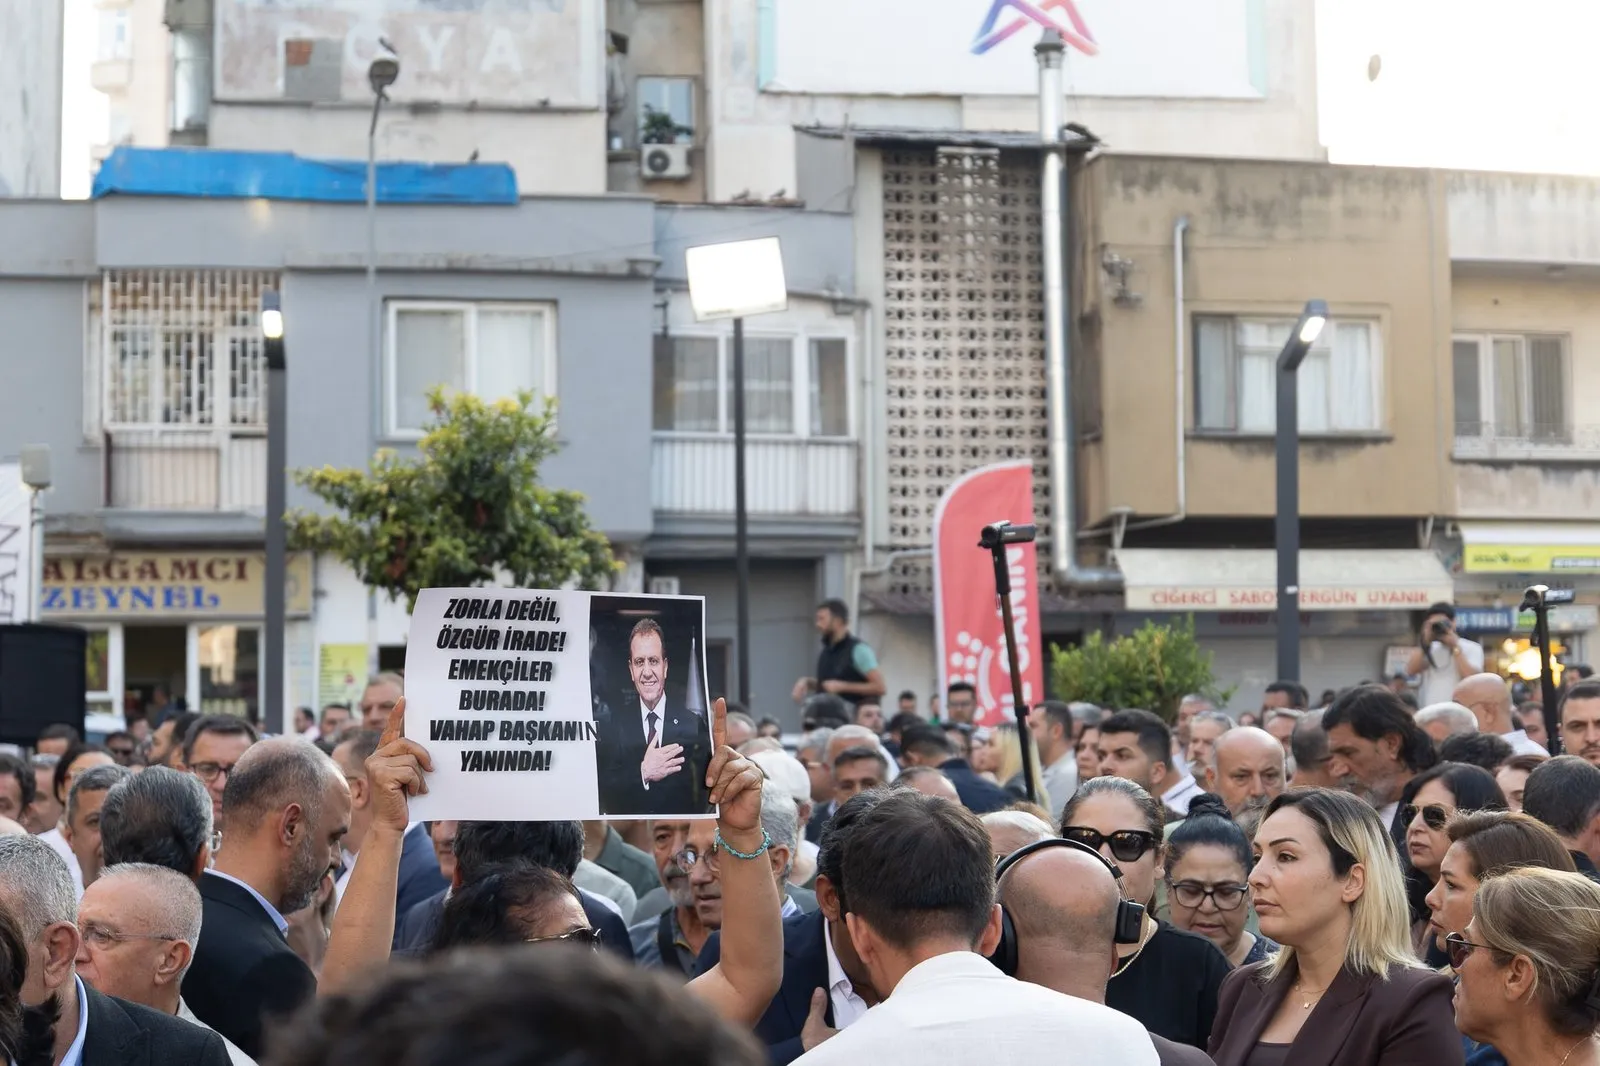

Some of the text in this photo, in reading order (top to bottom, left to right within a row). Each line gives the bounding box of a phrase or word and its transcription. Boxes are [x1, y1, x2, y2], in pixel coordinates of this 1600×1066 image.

[42, 586, 221, 609] ZEYNEL
[443, 596, 561, 624] ZORLA DEĞİL,
[437, 624, 567, 652] ÖZGÜR İRADE!
[448, 657, 553, 685] EMEKÇİLER
[458, 690, 546, 712] BURADA!
[429, 719, 600, 746] VAHAP BAŞKANIN
[460, 750, 552, 773] YANINDA!
